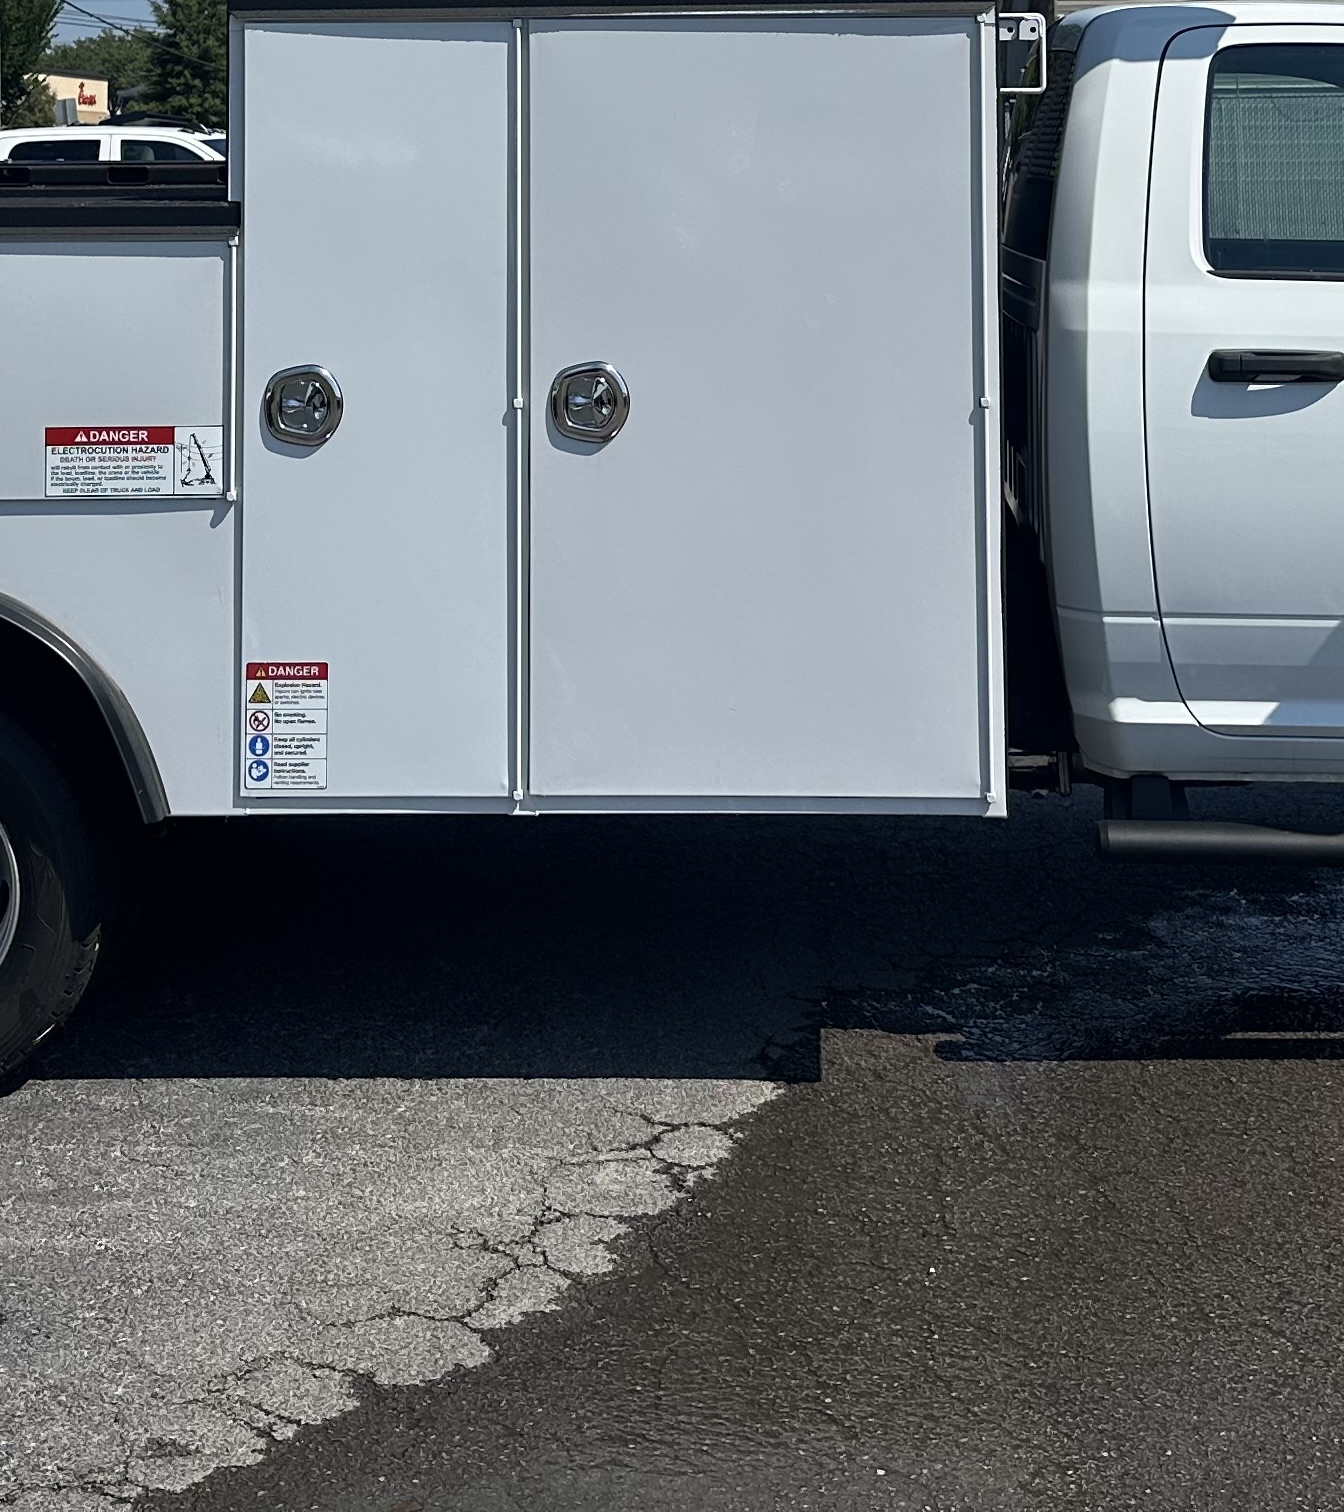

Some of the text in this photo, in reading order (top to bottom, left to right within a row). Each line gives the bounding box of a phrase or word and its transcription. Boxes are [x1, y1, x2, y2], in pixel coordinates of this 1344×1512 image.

[89, 430, 149, 442] DANGER
[51, 446, 169, 455] ELECTROCUTION HAZARD
[268, 666, 319, 676] DANGER
